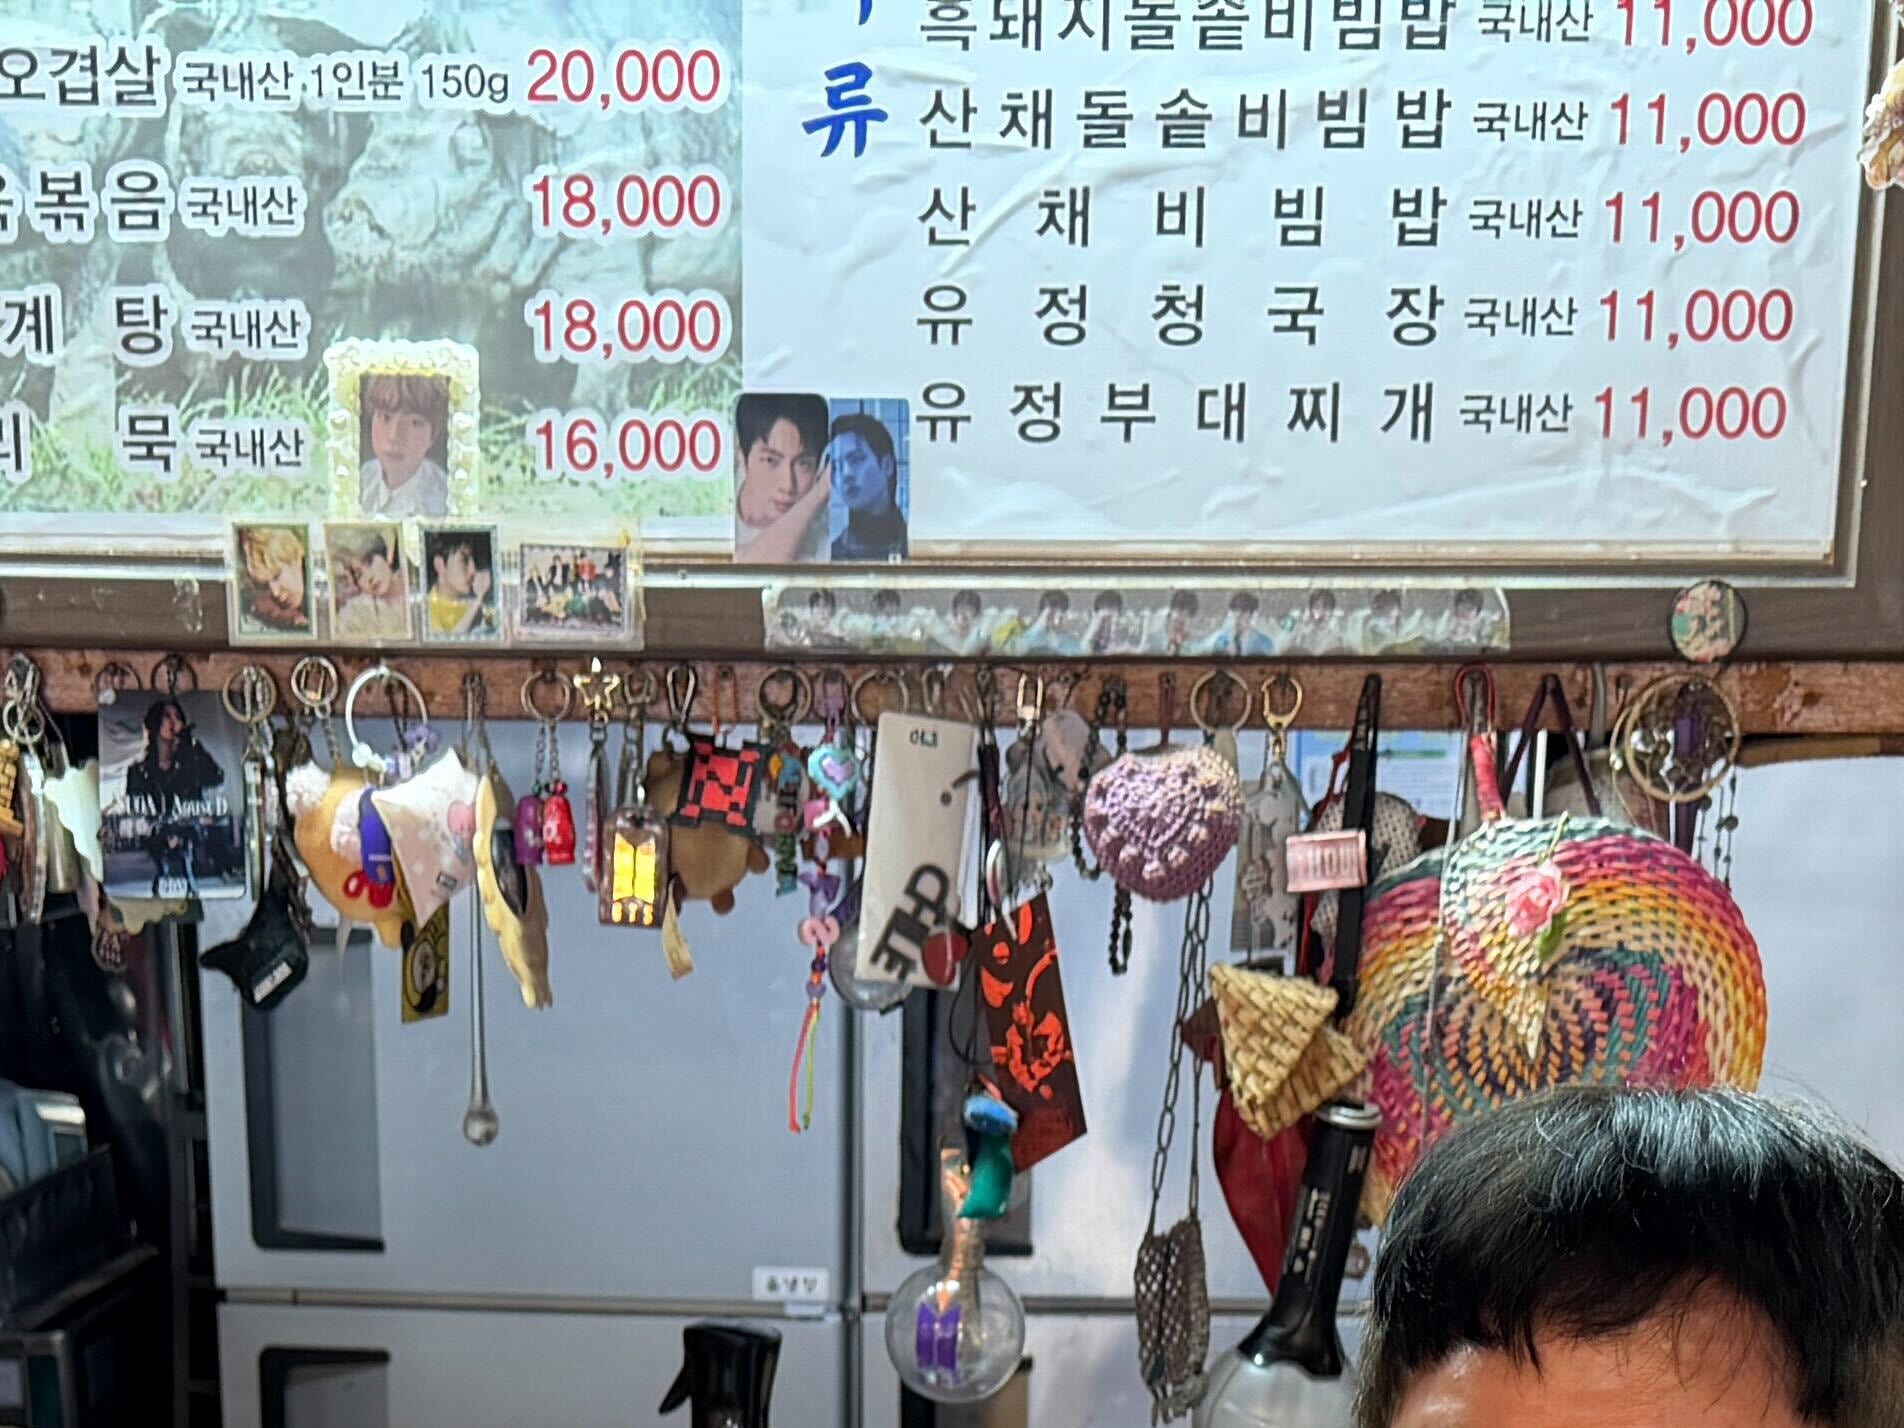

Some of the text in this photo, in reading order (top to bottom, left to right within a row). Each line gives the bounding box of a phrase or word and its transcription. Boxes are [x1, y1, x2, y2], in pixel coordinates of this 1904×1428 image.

[182, 58, 296, 104] 국내산
[421, 57, 511, 107] 150g
[526, 48, 722, 113] 20,000
[1471, 97, 1591, 145] 국내산
[1610, 92, 1806, 151] 11,000
[185, 182, 298, 230] 국내산
[530, 174, 722, 238] 18,000
[1469, 195, 1583, 243] 국내산
[1604, 189, 1801, 247] 11,000
[189, 304, 302, 352] 국내산
[531, 299, 723, 360] 18,000
[1465, 291, 1578, 340] 국내산
[1597, 287, 1794, 346] 11,000
[1459, 389, 1573, 440] 국내산
[1593, 384, 1788, 443] 11,000
[196, 422, 305, 470] 국내산
[535, 417, 723, 475] 16,000
